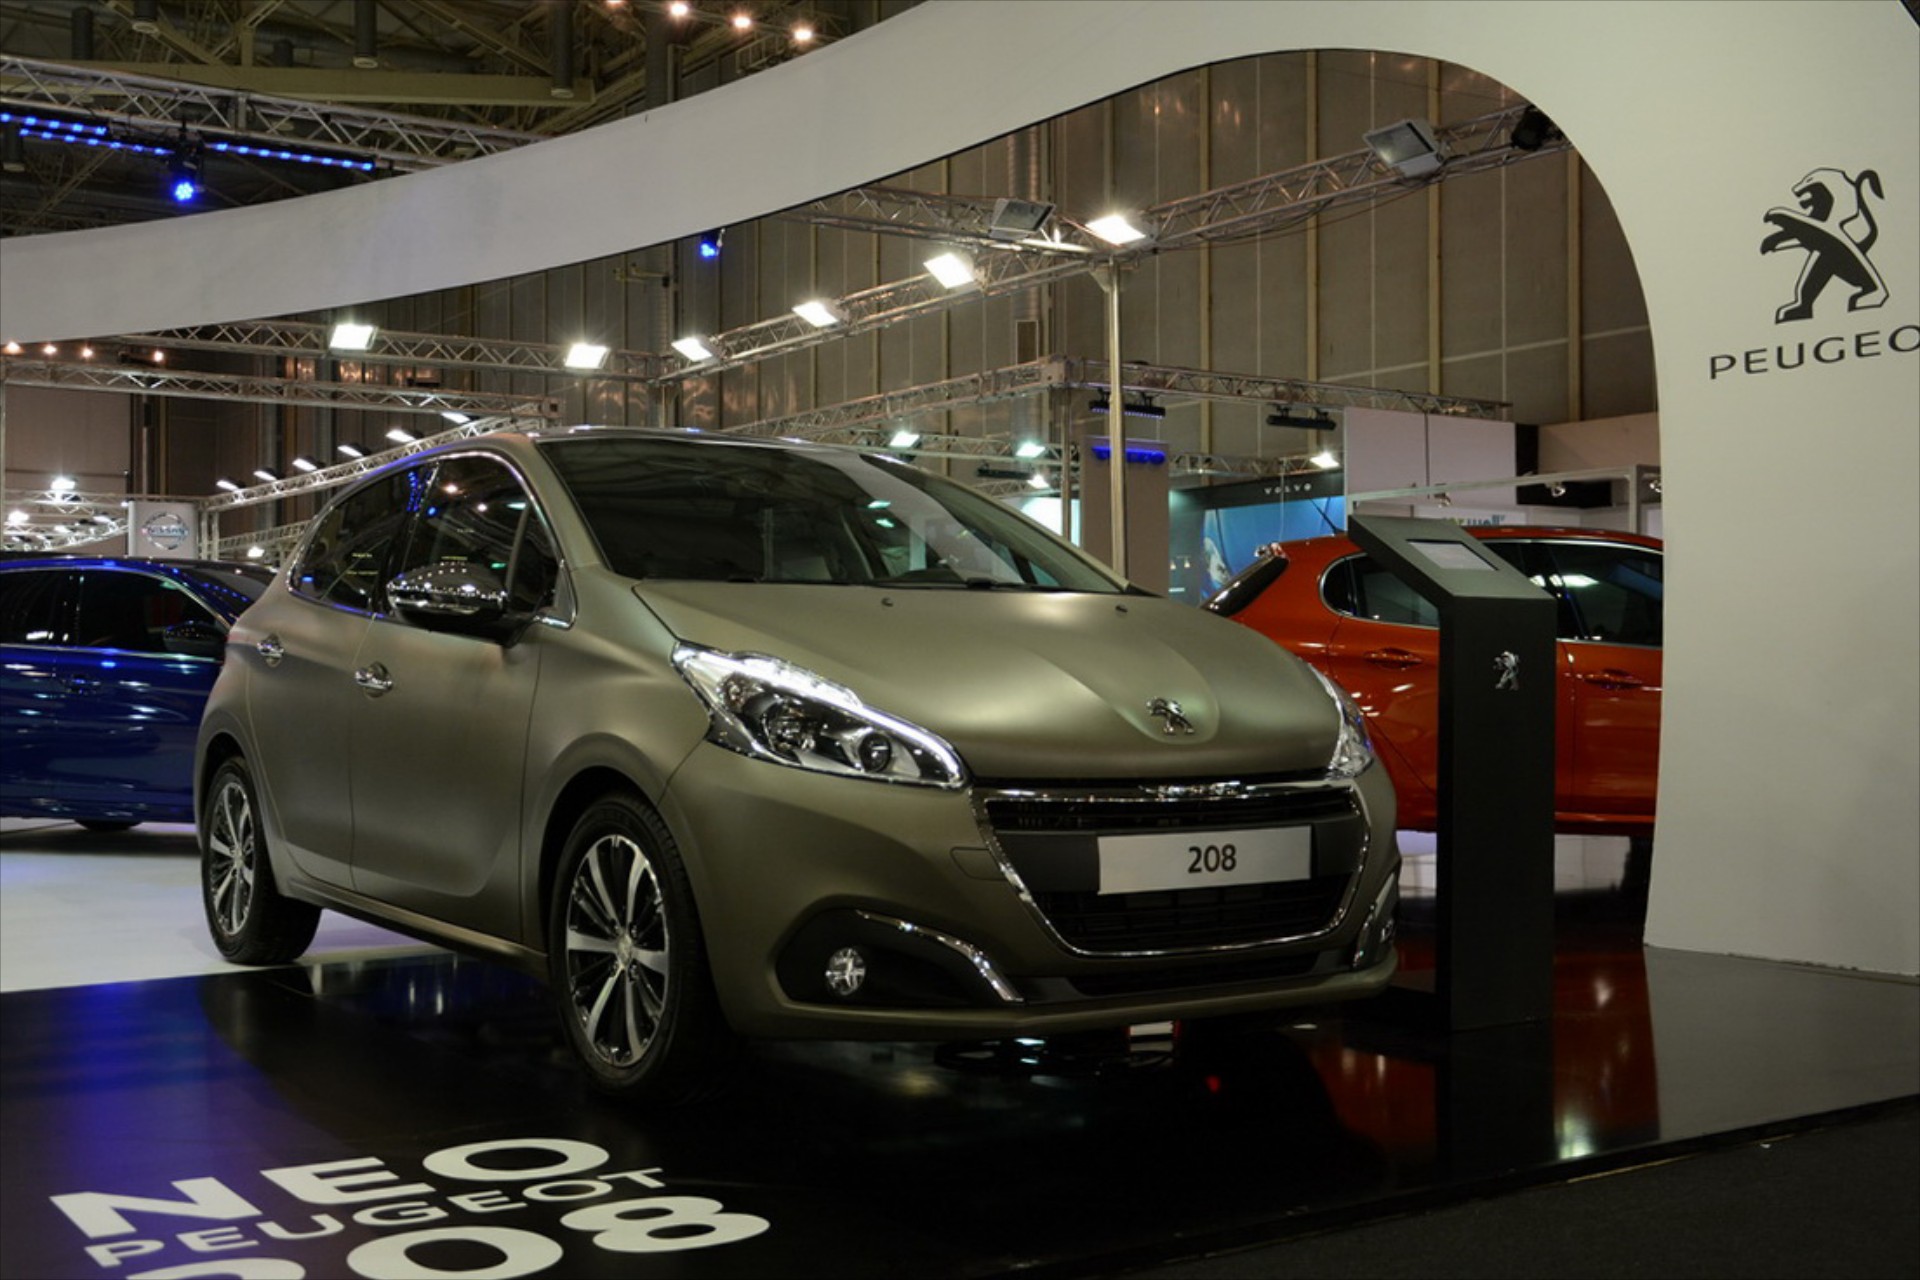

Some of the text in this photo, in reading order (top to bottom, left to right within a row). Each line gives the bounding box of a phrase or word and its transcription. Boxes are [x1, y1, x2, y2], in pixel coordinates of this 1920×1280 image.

[1709, 325, 1919, 380] PEUGEO
[1264, 483, 1312, 495] VOLVO
[1187, 843, 1237, 874] 208
[49, 1138, 609, 1239] NEO
[84, 1167, 666, 1267] PEUGEOT
